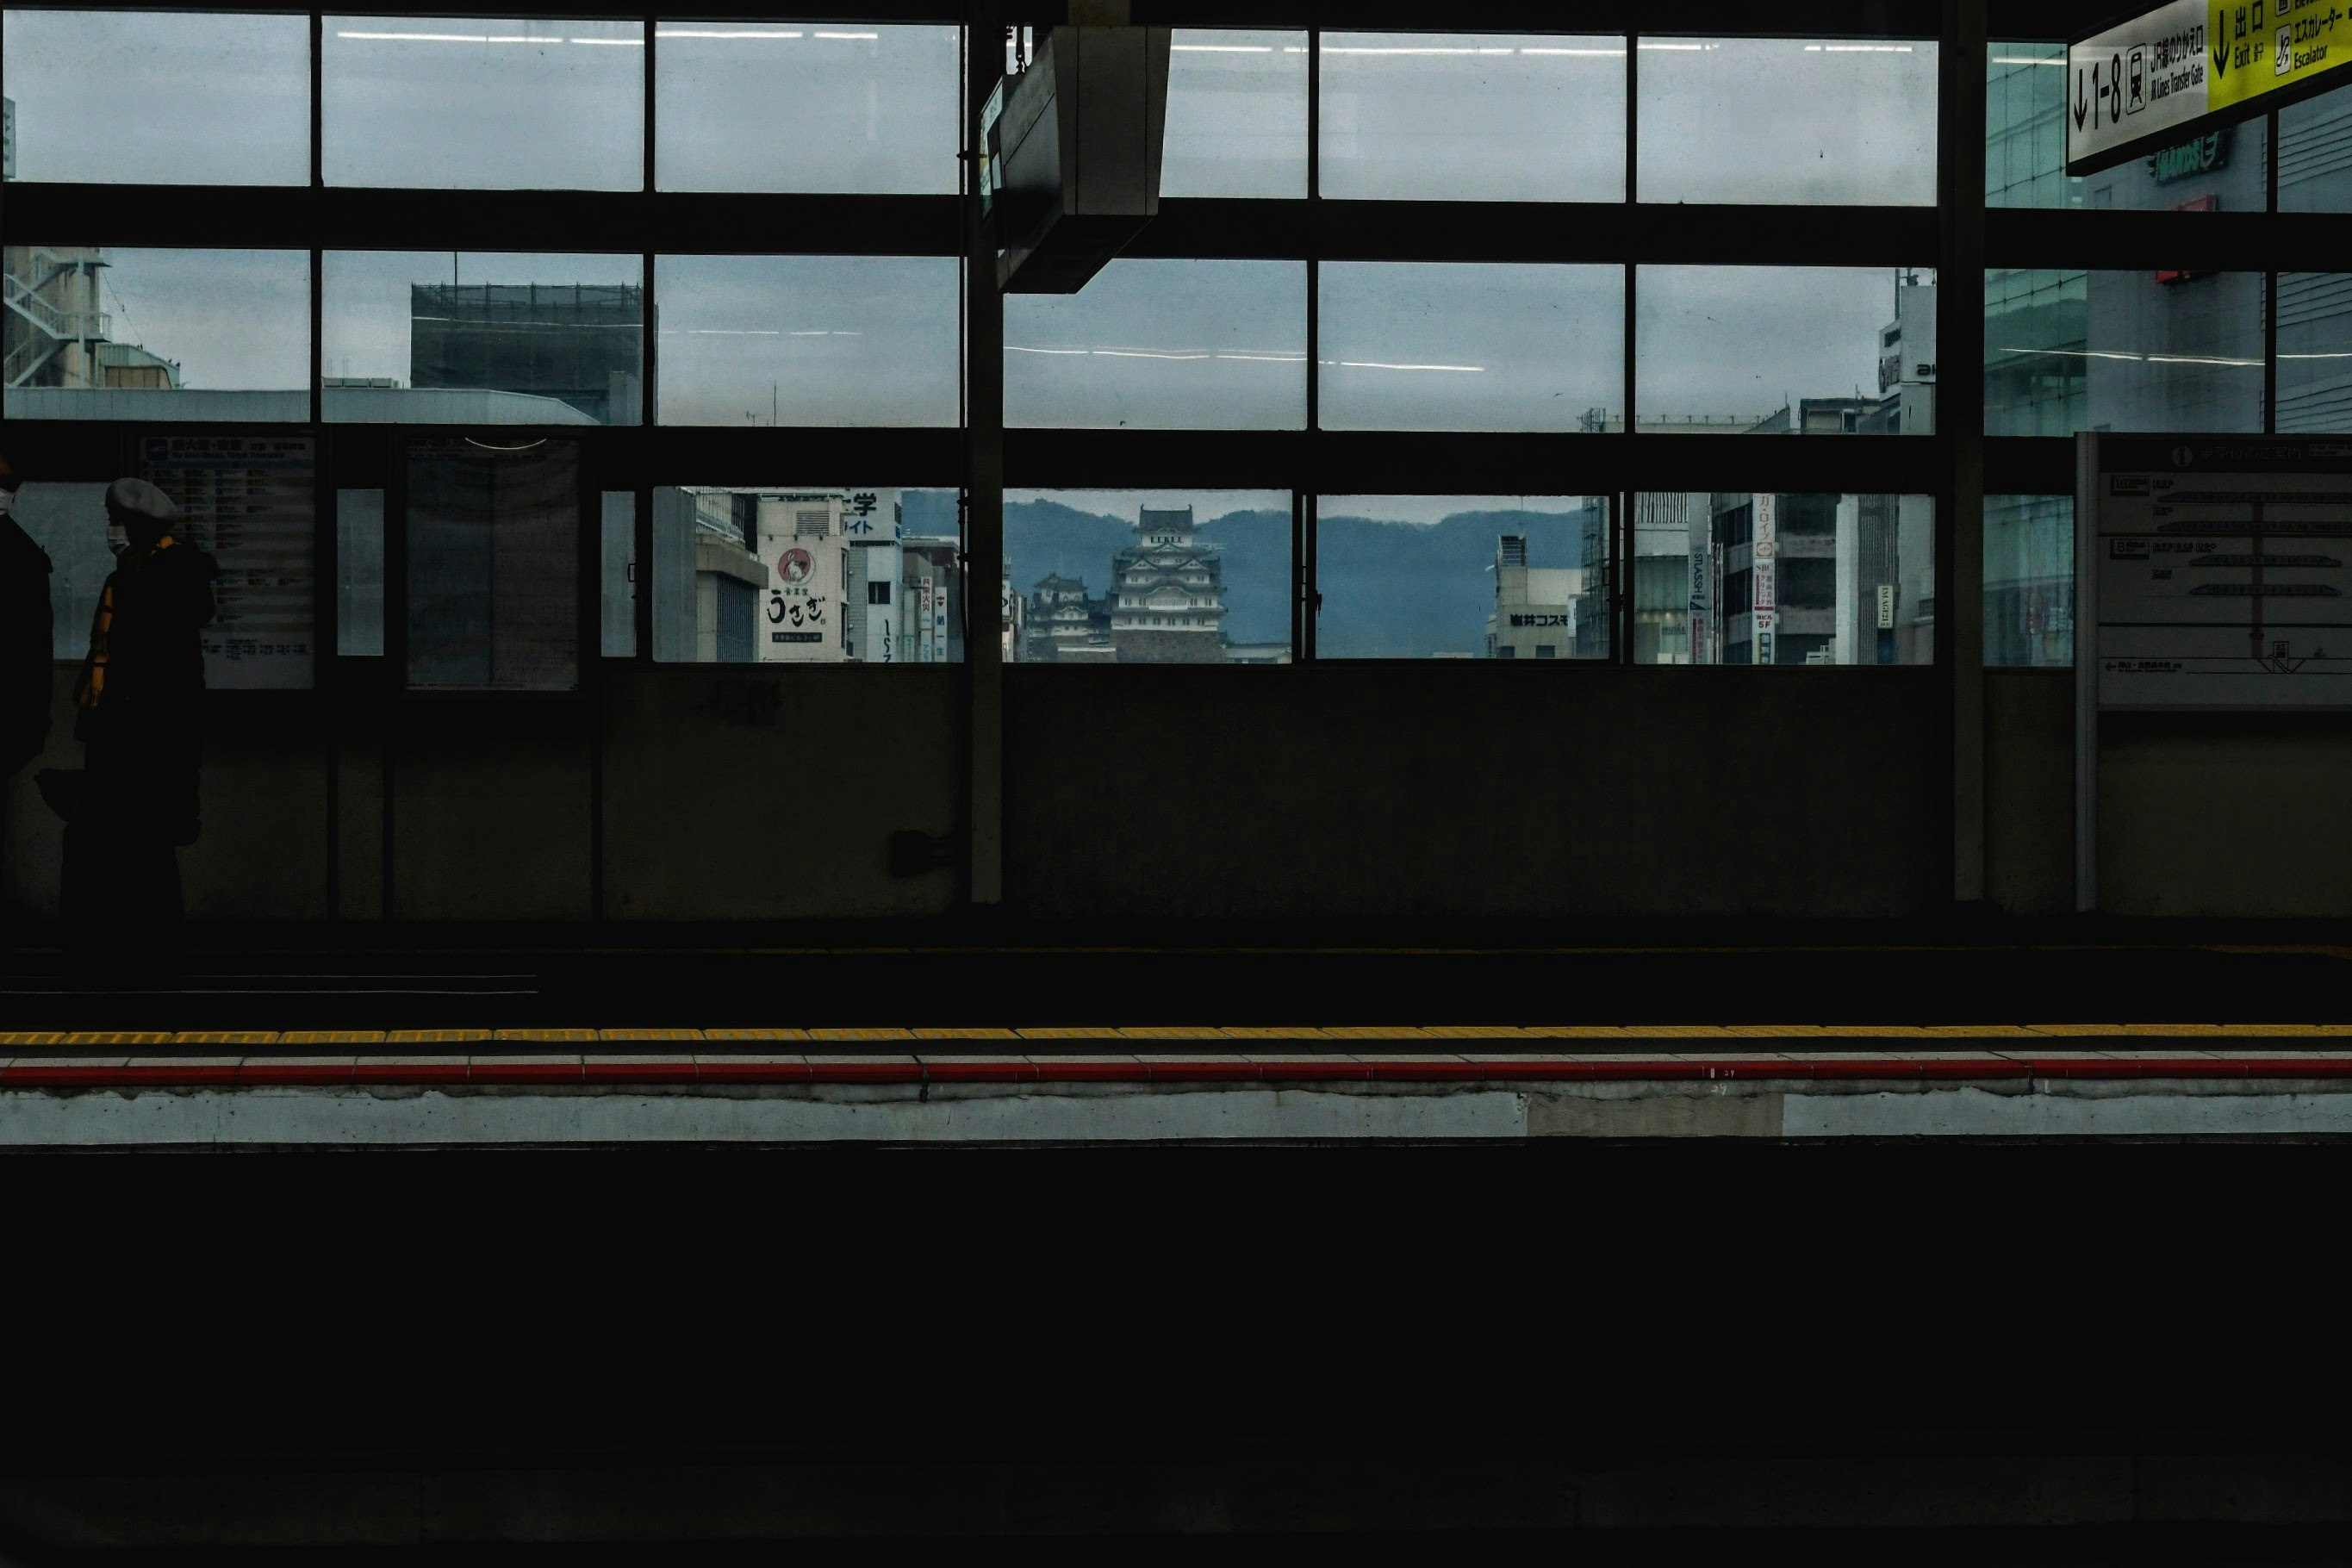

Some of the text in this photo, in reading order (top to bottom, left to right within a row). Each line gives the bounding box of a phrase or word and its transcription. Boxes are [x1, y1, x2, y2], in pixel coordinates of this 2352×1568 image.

[2235, 0, 2263, 40] 出口
[2294, 7, 2343, 43] エスカレーター
[2150, 25, 2204, 72] JR線のりかえ口
[2234, 43, 2250, 69] Exit
[2294, 44, 2329, 70] Escalator
[2092, 53, 2121, 129] 1-8
[2150, 64, 2204, 102] JR Lines Transfer Gate
[767, 589, 826, 628] うさぎ
